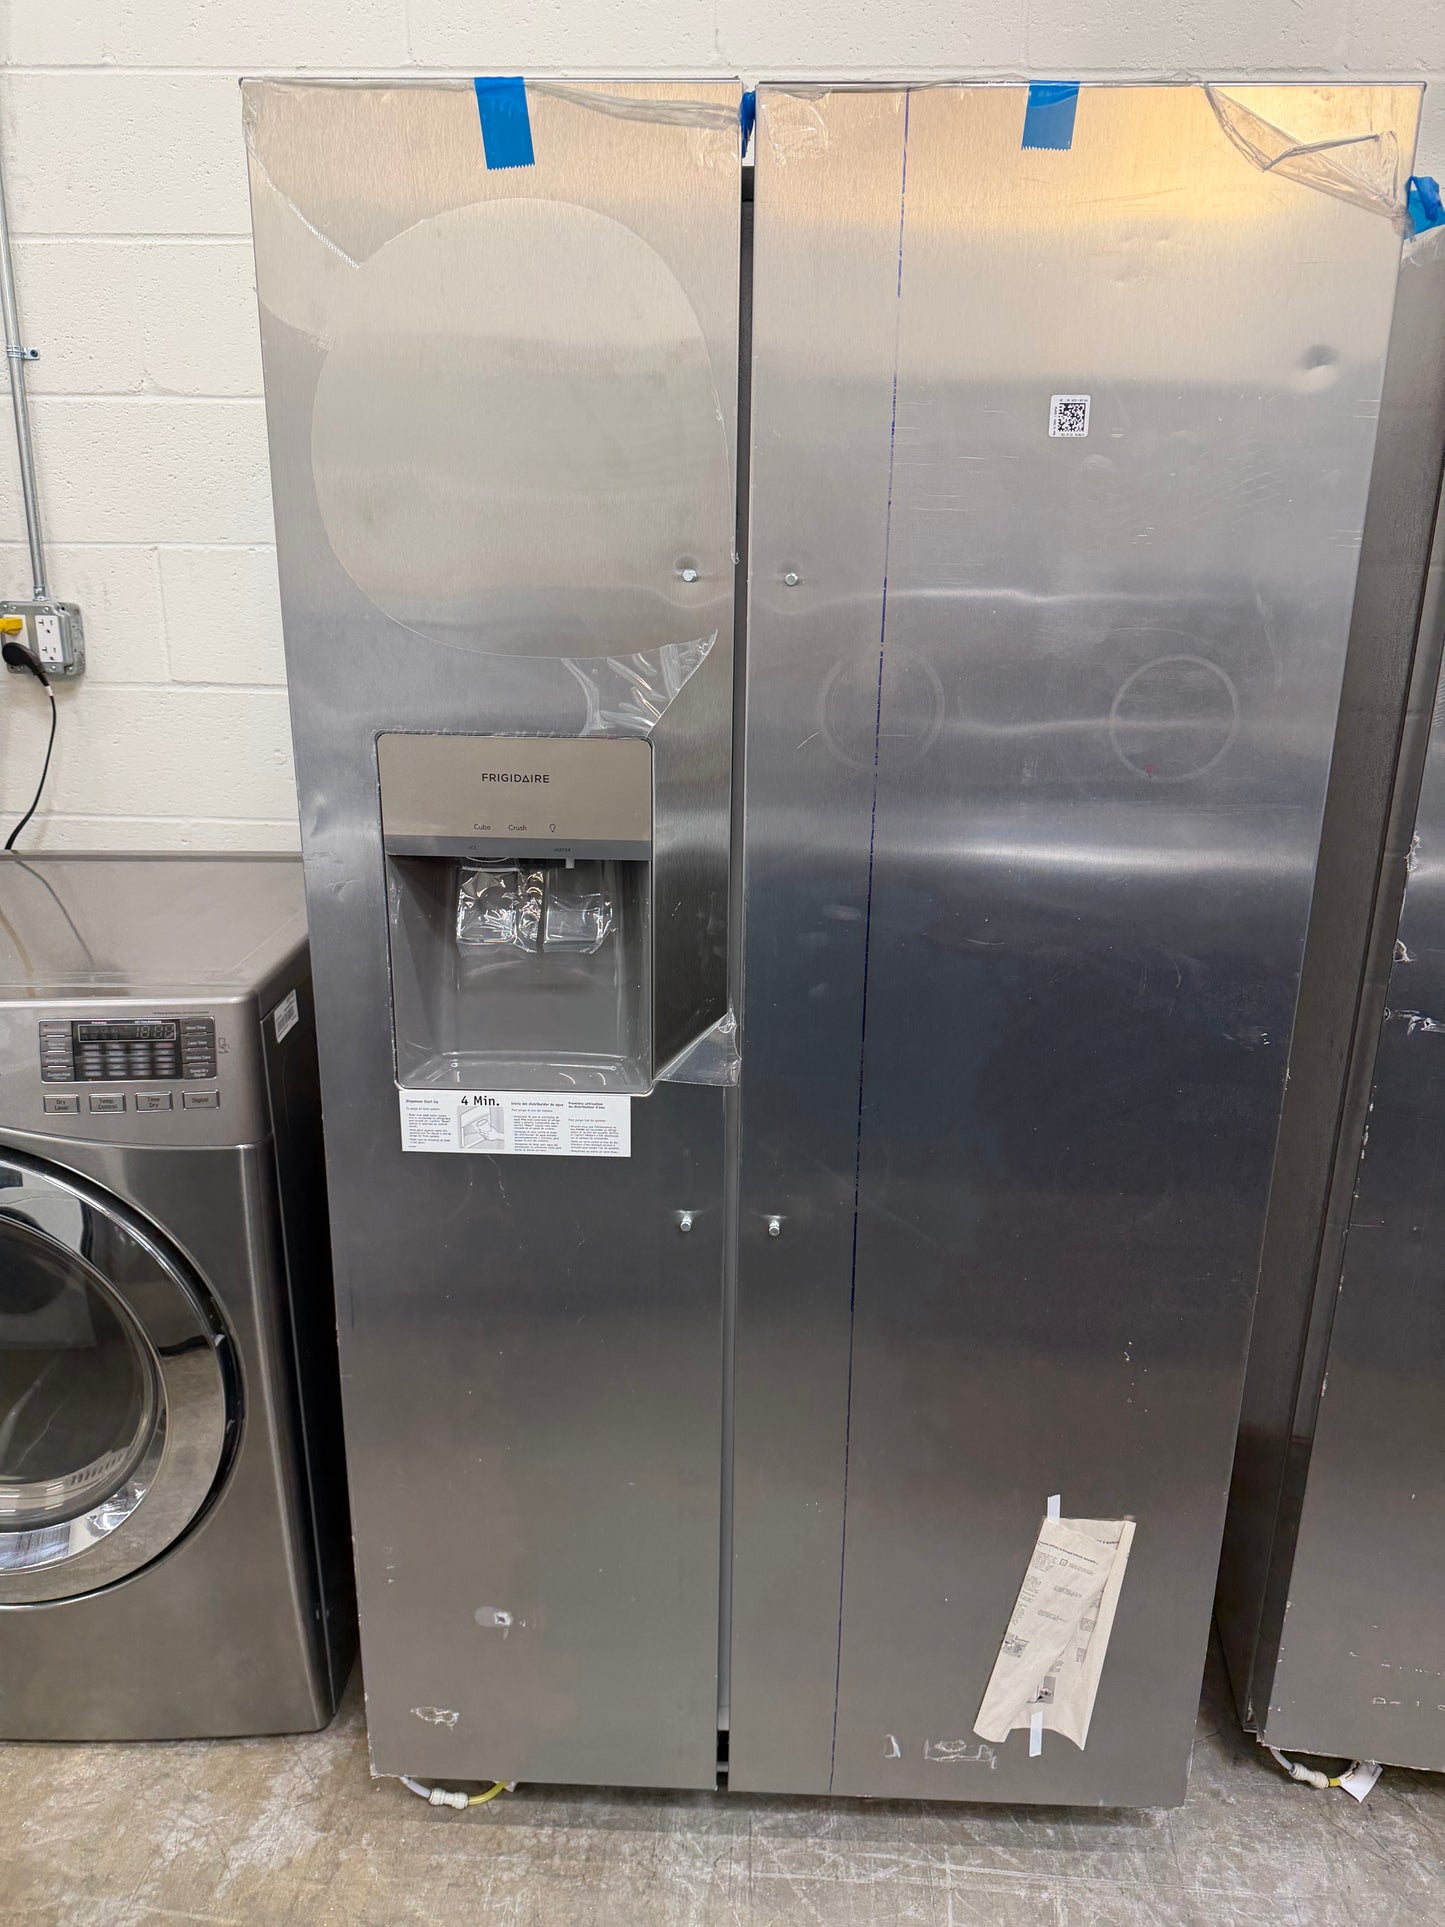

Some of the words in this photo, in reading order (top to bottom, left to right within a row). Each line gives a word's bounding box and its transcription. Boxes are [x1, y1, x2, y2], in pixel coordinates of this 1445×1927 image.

[481, 773, 550, 784] FRIGIDAIRE
[473, 823, 492, 831] Cube
[508, 823, 528, 832] Crush
[460, 1095, 469, 1106] 4
[473, 1095, 500, 1106] Min.
